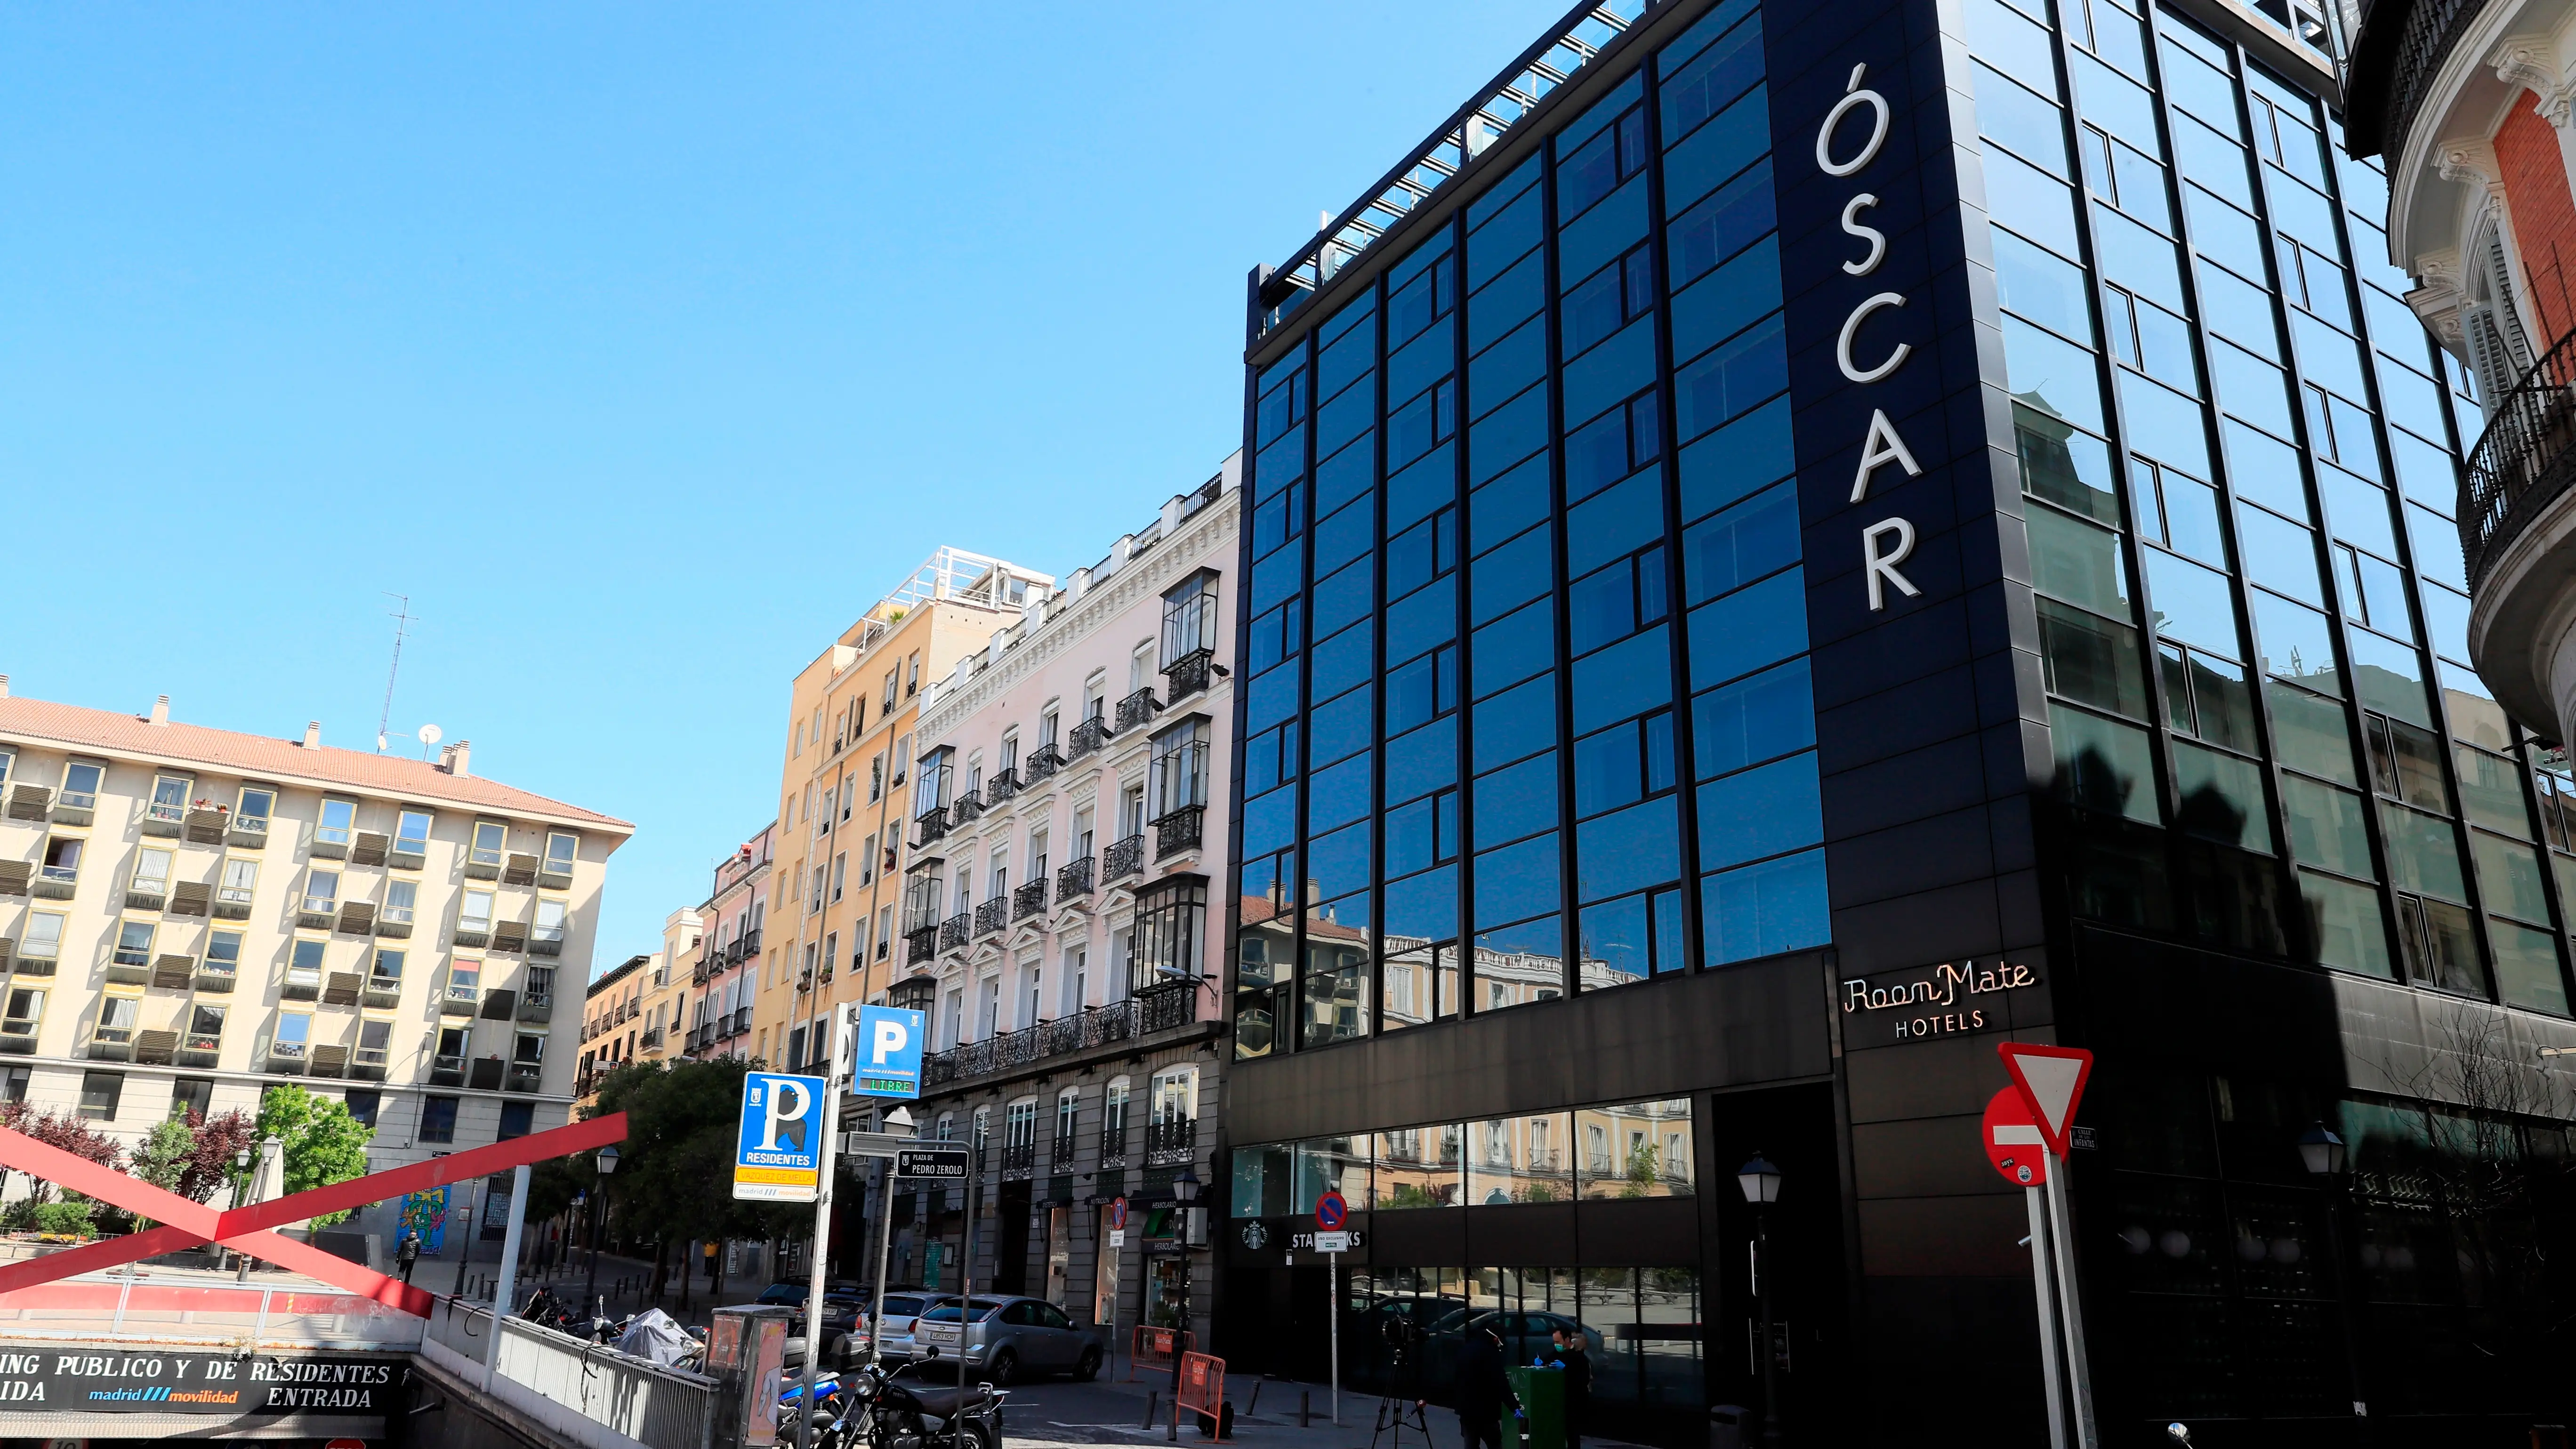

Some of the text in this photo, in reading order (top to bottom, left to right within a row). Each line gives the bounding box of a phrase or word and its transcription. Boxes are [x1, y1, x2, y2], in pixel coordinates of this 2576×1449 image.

[1816, 62, 1923, 612] ÓSCAR
[1843, 960, 2035, 1013] Room Mate
[1895, 1010, 1984, 1038] HOTELS
[872, 1020, 908, 1064] P
[871, 1079, 910, 1093] LIBRE
[2074, 1139, 2095, 1148] INFANTAS
[746, 1152, 810, 1166] RESIDENTES
[741, 1171, 812, 1183] VAZQUEZ DE MELLA
[912, 1165, 962, 1175] PEDRO ZEROLO
[738, 1187, 763, 1195] madrid
[1152, 1201, 1177, 1209] HERBOLARIO
[1292, 1232, 1360, 1248] STAKS
[54, 1356, 162, 1377] PUBLICO
[176, 1360, 192, 1379] Y
[205, 1360, 238, 1380] DE
[250, 1362, 390, 1384] RESIDENTES
[0, 1381, 371, 1408] IDA madrid movilidad ENTRADA
